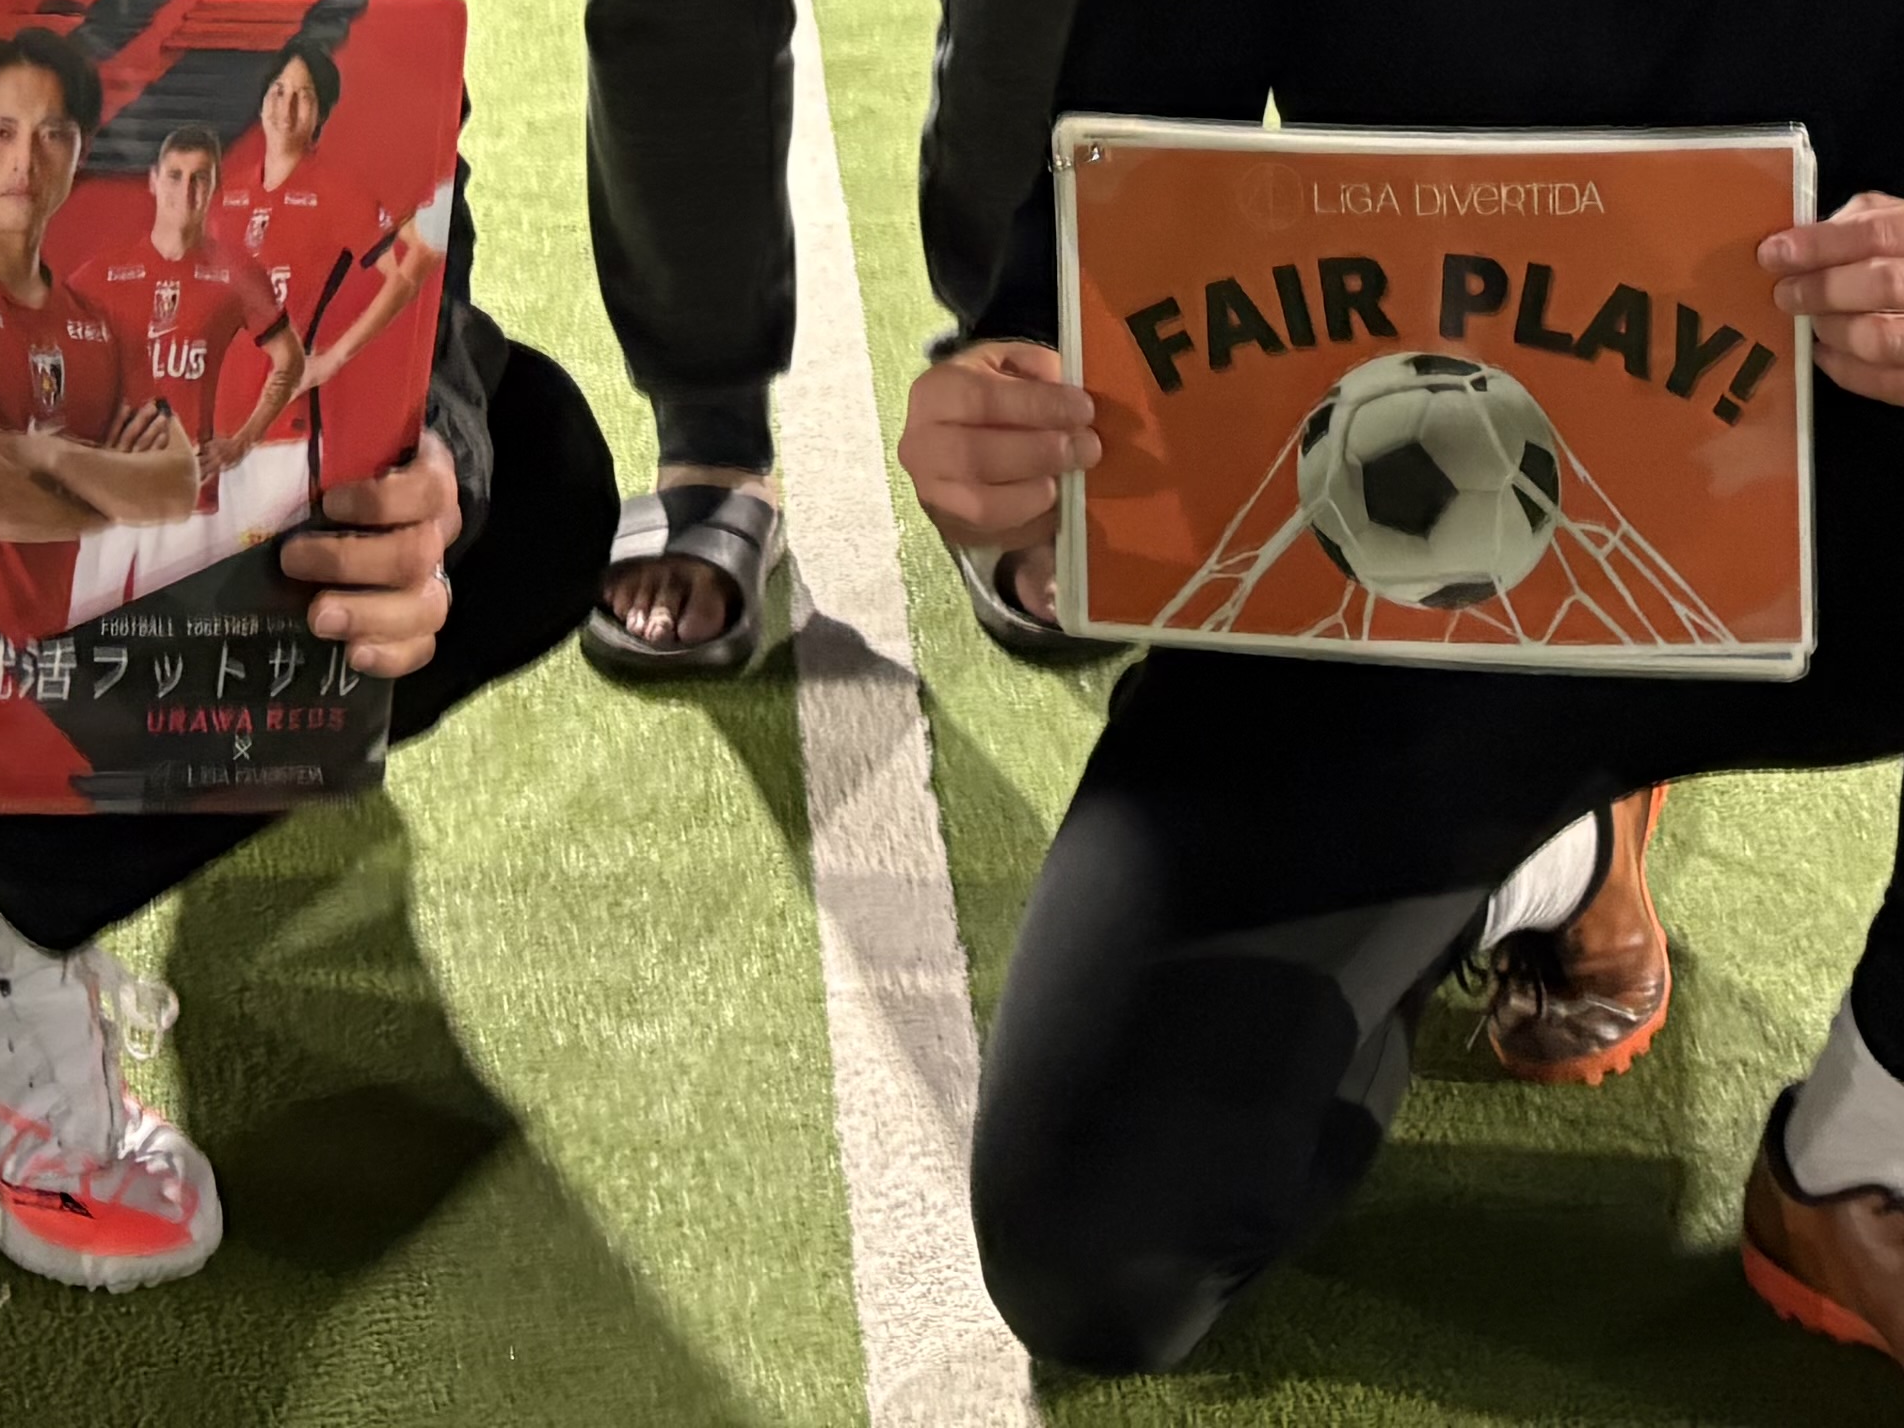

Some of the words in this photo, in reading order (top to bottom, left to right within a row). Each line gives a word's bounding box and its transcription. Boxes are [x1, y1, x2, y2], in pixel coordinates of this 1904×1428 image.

[1125, 255, 1399, 394] FAIR
[1438, 252, 1777, 427] PLAY!
[147, 706, 254, 734] URAWA
